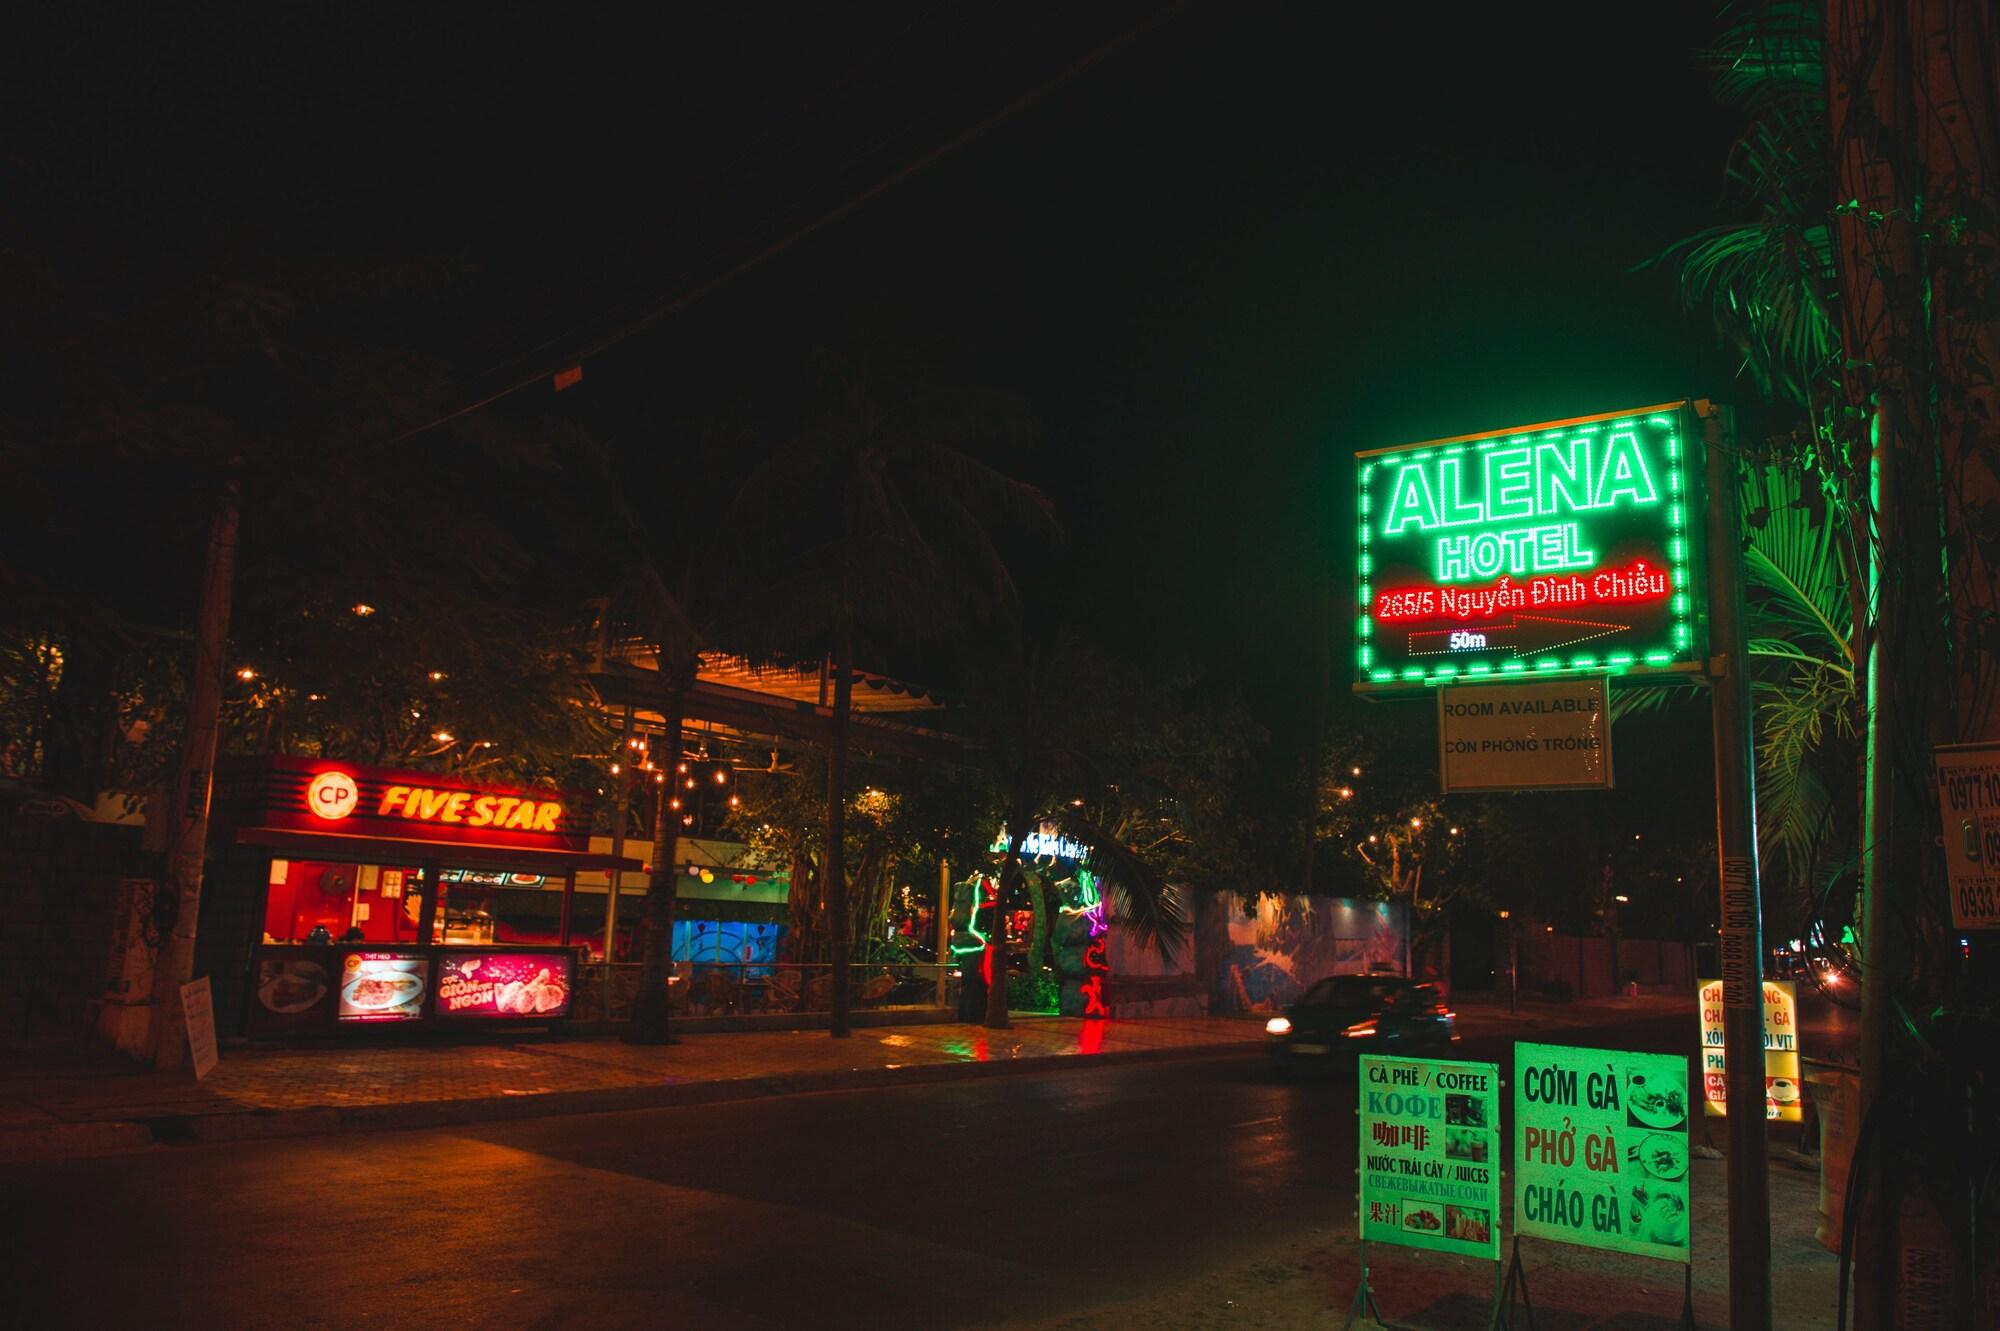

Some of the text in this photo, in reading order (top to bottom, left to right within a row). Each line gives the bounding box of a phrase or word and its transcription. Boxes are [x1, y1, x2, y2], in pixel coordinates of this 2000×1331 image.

[1385, 431, 1657, 534] ALENA
[1438, 522, 1594, 580] HOTEL
[1379, 591, 1435, 617] 265/5
[1531, 577, 1586, 605] Đình
[1450, 632, 1487, 649] 50m
[1444, 698, 1599, 717] ROOM AVAILABLE
[318, 785, 349, 805] CP
[378, 786, 562, 832] FIVE STAR
[450, 990, 493, 1009] NGON
[1369, 1064, 1488, 1092] CÀ PHÊ / COFFEE
[1524, 1064, 1620, 1111] CƠM GÀ
[1367, 1091, 1442, 1120] КОФЕ
[1373, 1121, 1430, 1151] 咖啡
[1525, 1116, 1619, 1173] PHỞ GÀ
[1367, 1154, 1489, 1184] NƯỚC TRÁI CÂY / JUICES
[1458, 1186, 1488, 1202] СОКИ
[1524, 1179, 1622, 1234] CHÁO GÀ
[1369, 1201, 1400, 1225] 果汁
